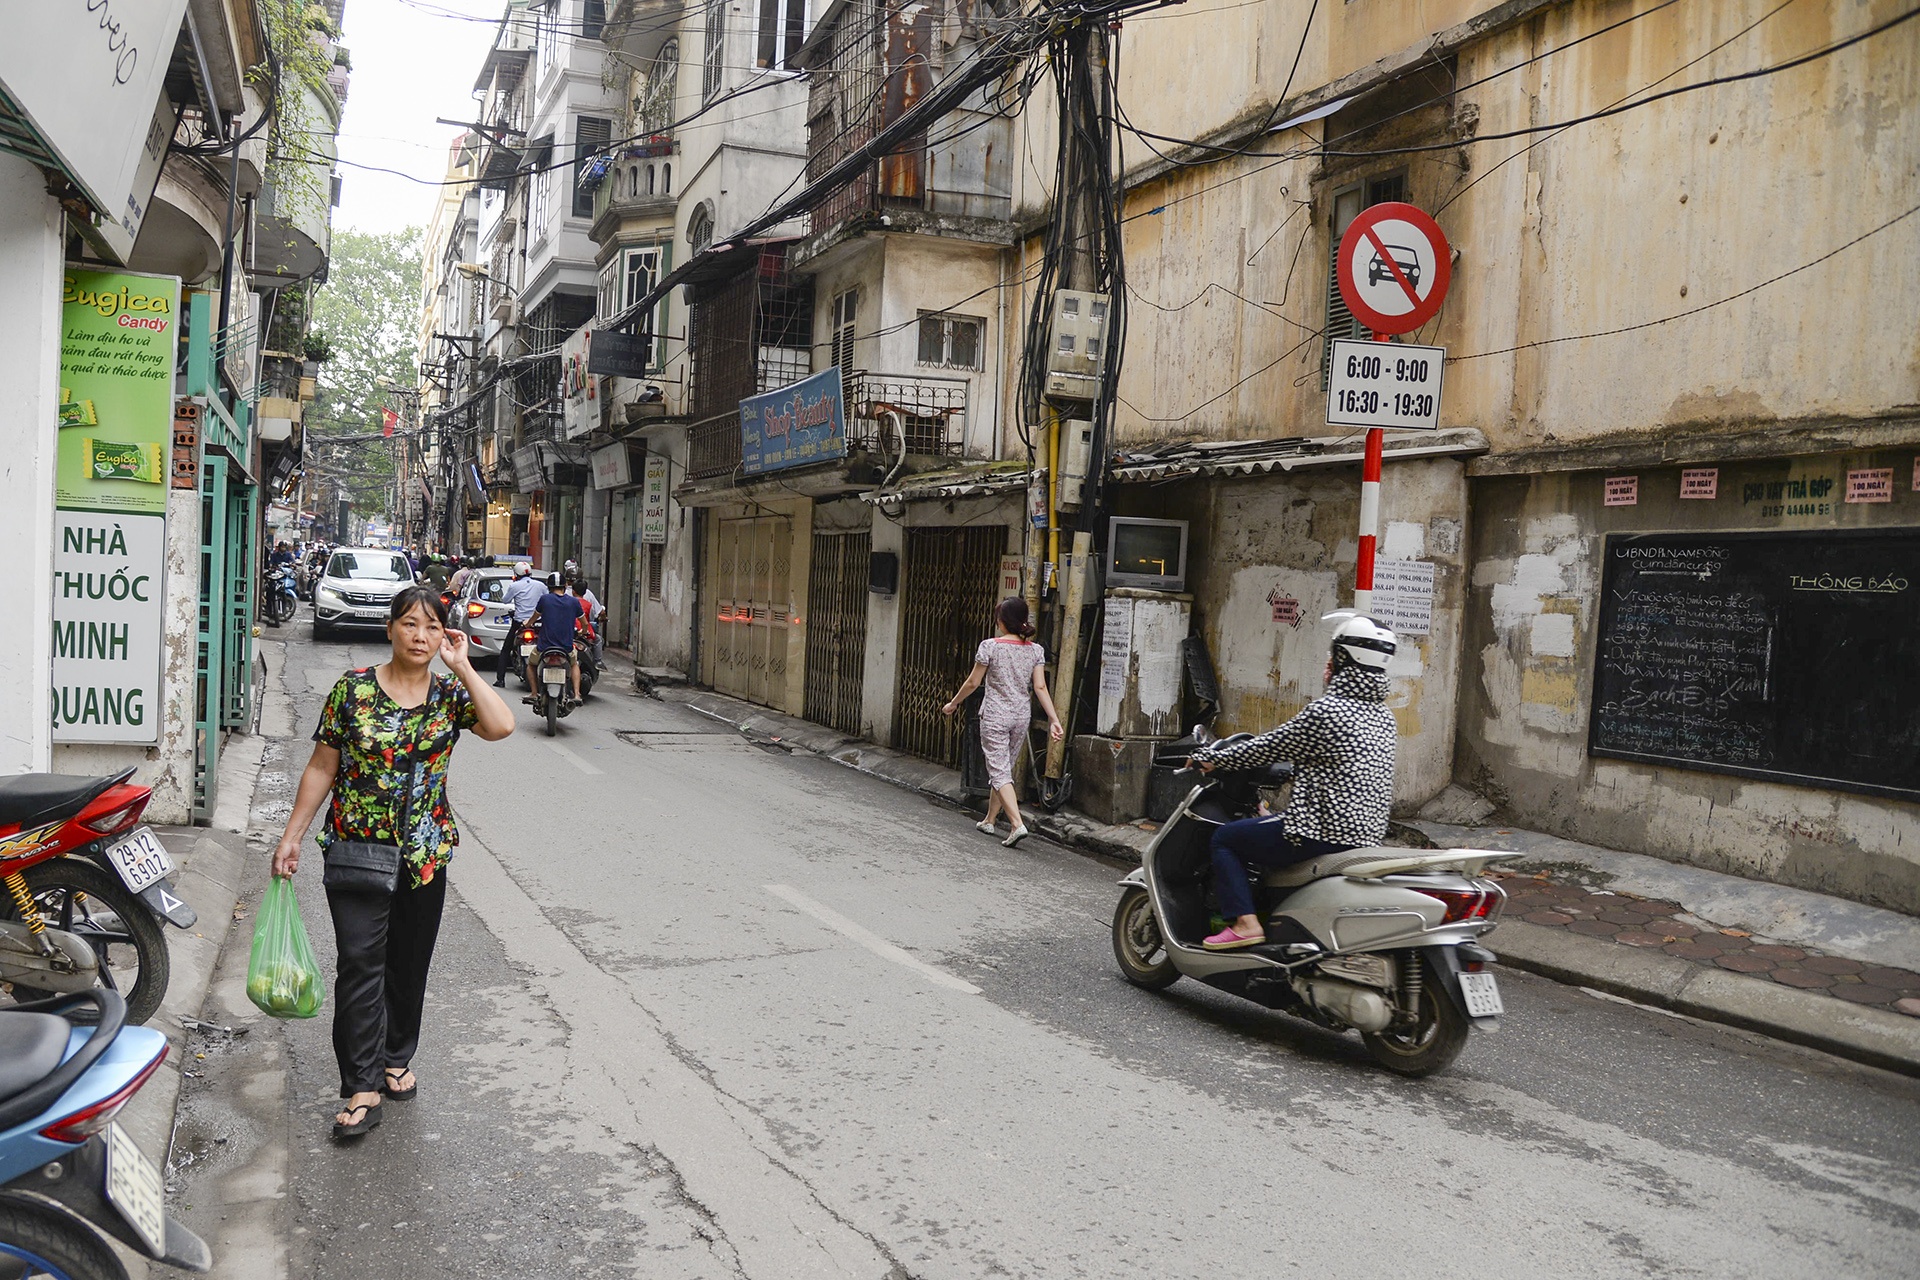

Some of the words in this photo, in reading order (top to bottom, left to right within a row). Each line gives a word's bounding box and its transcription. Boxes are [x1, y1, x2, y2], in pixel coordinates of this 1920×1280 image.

[63, 276, 170, 317] Eugica
[117, 314, 169, 333] Candy
[67, 329, 94, 341] Làm
[97, 331, 116, 345] dịu
[119, 334, 134, 345] ho
[136, 336, 151, 347] và
[60, 345, 85, 356] iảm
[88, 346, 111, 359] đau
[114, 350, 134, 360] rát
[135, 351, 164, 366] họng
[70, 362, 96, 375] quả
[97, 363, 111, 374] từ
[112, 365, 138, 377] thảo
[1346, 355, 1381, 380] 6:00
[1396, 358, 1428, 383] 9:00
[1338, 389, 1379, 414] 16:30
[1394, 393, 1433, 417] 19:30
[764, 404, 792, 449] Shop
[794, 389, 837, 440] Beauty
[95, 451, 137, 466] Eugica
[1787, 474, 1807, 499] TRẢ
[1809, 475, 1833, 498] GÓP
[1853, 482, 1865, 490] 100
[1867, 480, 1886, 490] NGÀY
[650, 495, 660, 503] EM
[63, 523, 128, 556] NHÀ
[1616, 547, 1657, 558] UBND
[1668, 549, 1696, 558] NAM
[1005, 576, 1017, 590] TIVI
[1398, 574, 1432, 583] 0984.098.094
[1790, 572, 1862, 589] THÔNG
[1868, 572, 1908, 590] BÁO
[1398, 585, 1431, 593] 0963.868.449
[1396, 611, 1430, 620] 0984.098.094
[1395, 621, 1429, 630] 0963.868.449
[128, 854, 167, 885] 6902
